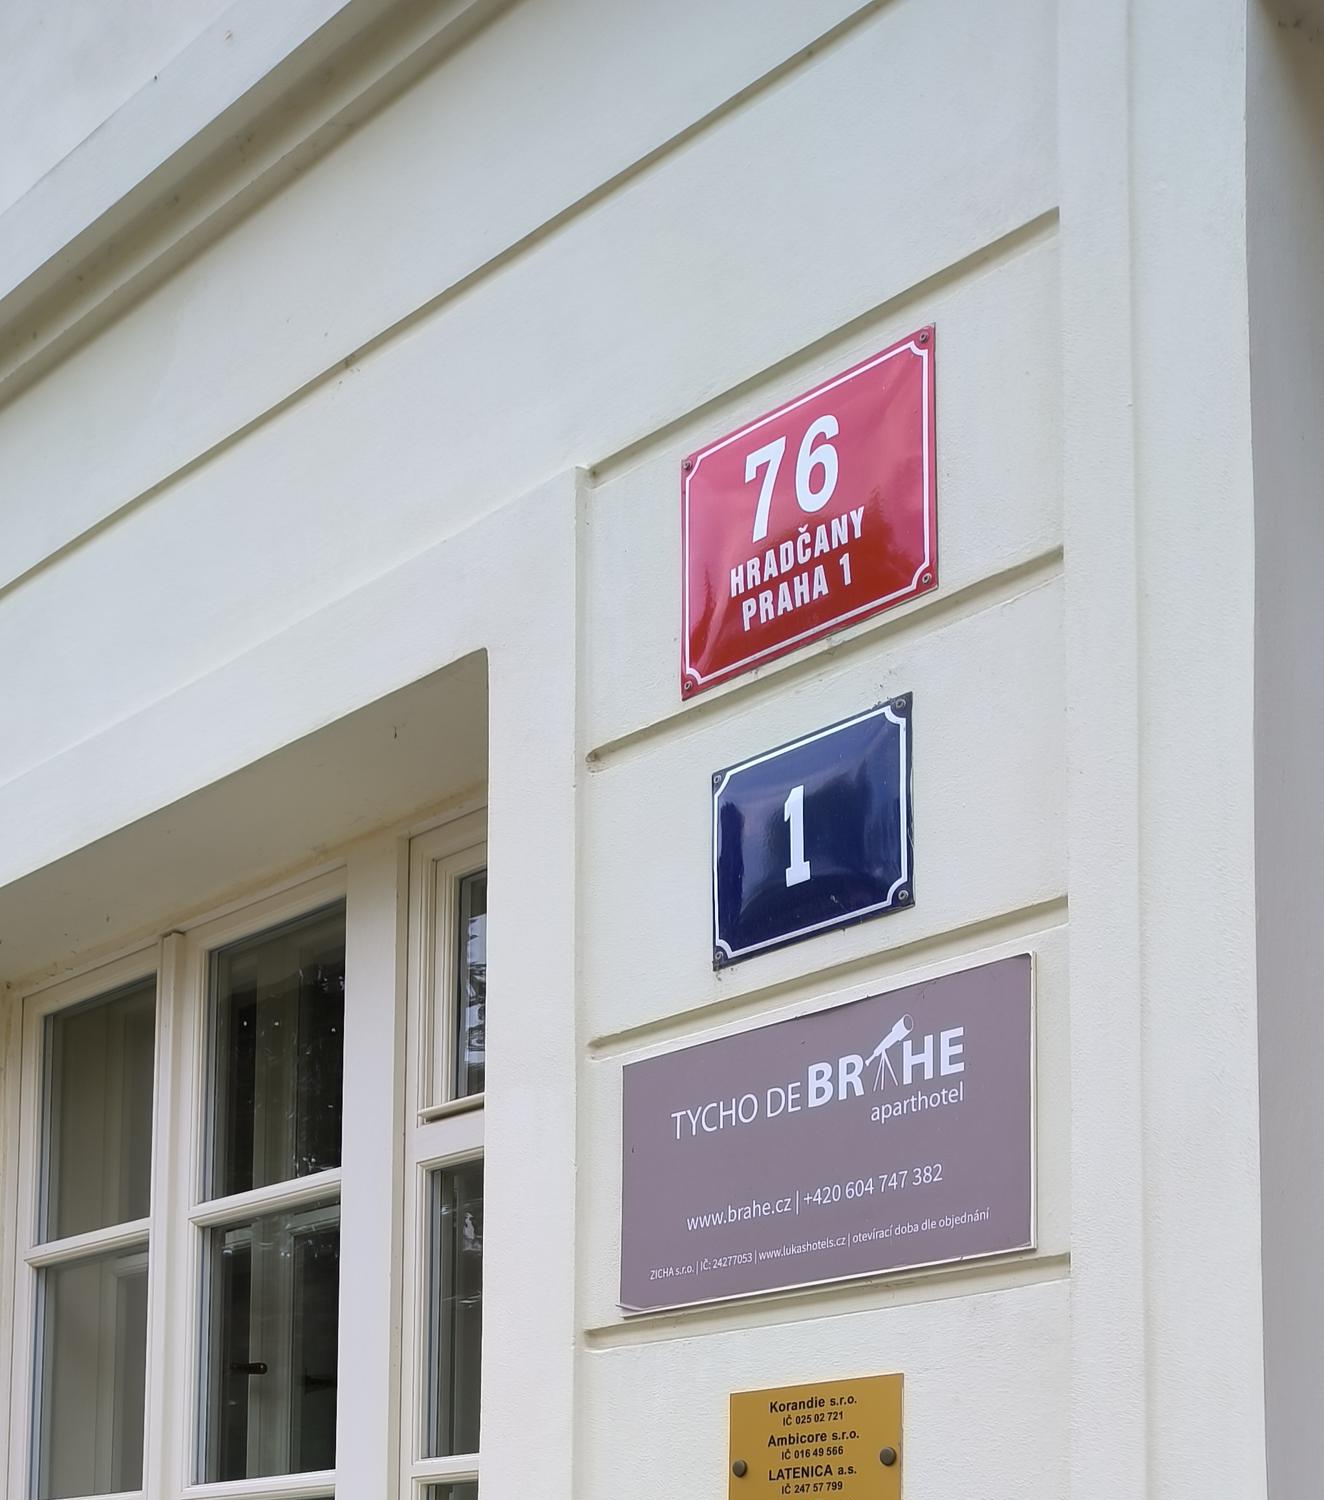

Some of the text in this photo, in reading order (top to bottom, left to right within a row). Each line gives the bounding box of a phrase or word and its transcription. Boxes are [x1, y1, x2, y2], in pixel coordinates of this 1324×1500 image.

[744, 414, 840, 544] 76
[730, 506, 865, 598] HRADČANY
[742, 552, 852, 632] PRAHA 1
[784, 785, 811, 888] 1
[671, 1093, 758, 1140] TYCHO
[766, 1081, 801, 1118] DE
[870, 1081, 964, 1124] aparthotel
[687, 1163, 943, 1231] www.brahe.cz +420 604 747 382
[650, 1267, 675, 1281] ZICHA
[676, 1265, 695, 1276] s.r.o.
[712, 1252, 753, 1270] 24277053
[758, 1234, 847, 1261] www.lukashotels.cz
[852, 1224, 893, 1244] otevírací
[894, 1221, 919, 1236] doba
[921, 1217, 937, 1232] dle
[938, 1207, 990, 1230] objednání
[769, 1395, 857, 1413] Korandie s.r.o.
[782, 1410, 844, 1426] IČ 025 02 721
[768, 1430, 860, 1447] Ambicore s.r.o.
[781, 1448, 792, 1461] IČ
[794, 1448, 811, 1459] 016
[812, 1447, 824, 1458] 49
[769, 1464, 857, 1481] LATENICA a.s.
[781, 1480, 843, 1495] IČ 247 57 799
